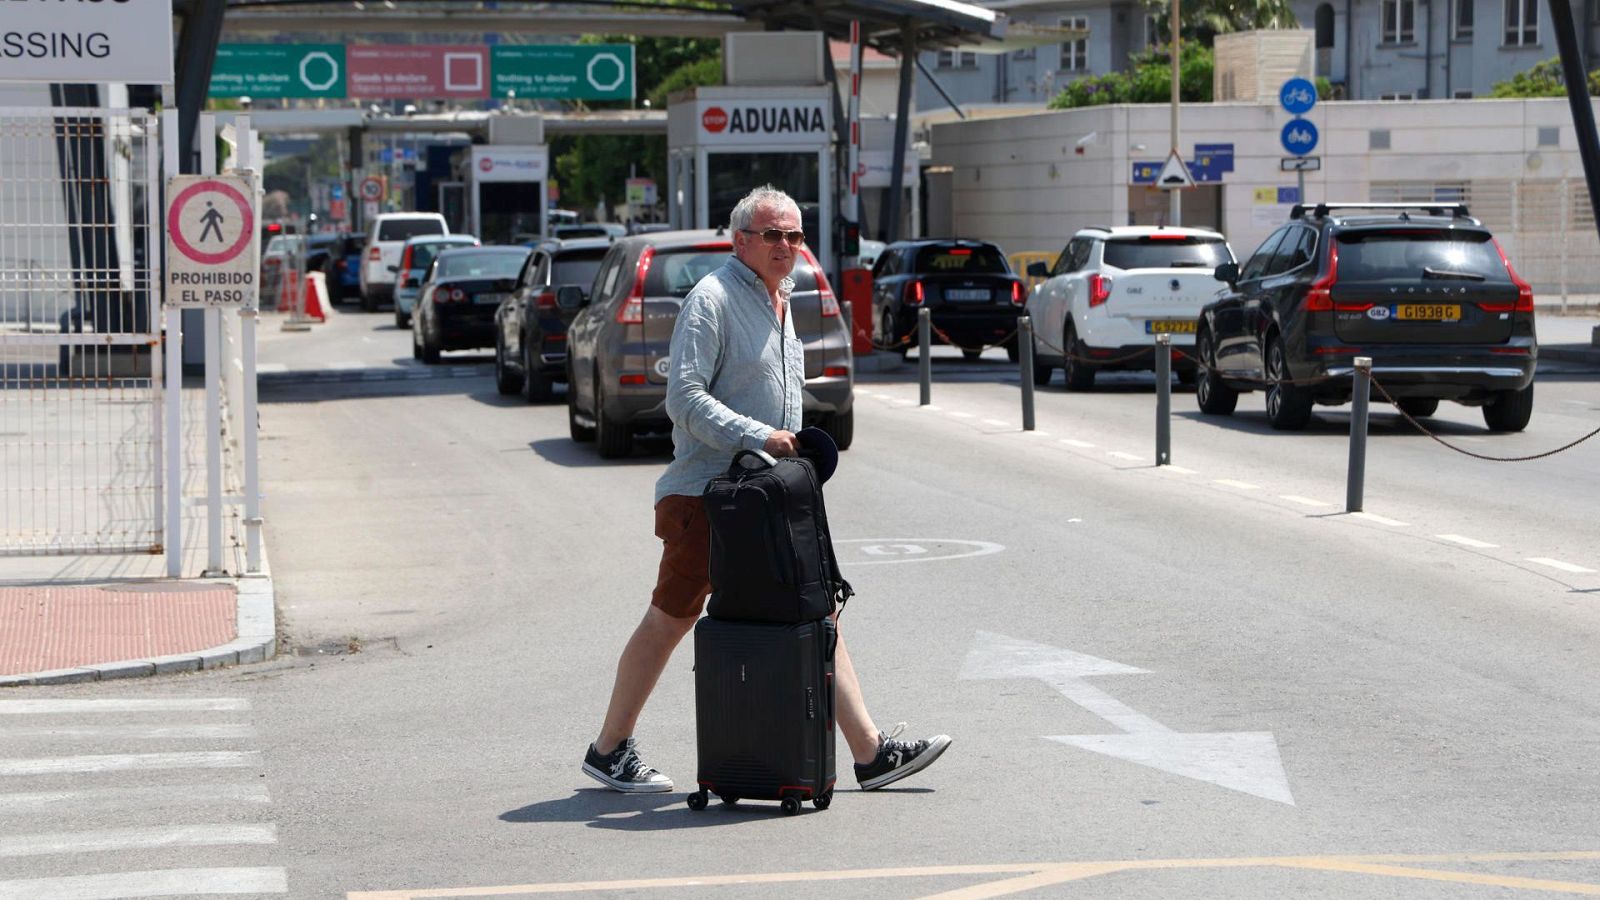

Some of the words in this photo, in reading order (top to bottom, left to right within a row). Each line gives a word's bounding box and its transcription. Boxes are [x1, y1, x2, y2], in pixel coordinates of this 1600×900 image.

[0, 32, 110, 58] SSING
[729, 107, 826, 133] ADUANA
[171, 272, 253, 284] PROHIBIDO
[182, 290, 199, 301] EL
[204, 290, 242, 302] PASO
[1370, 309, 1387, 317] GBZ
